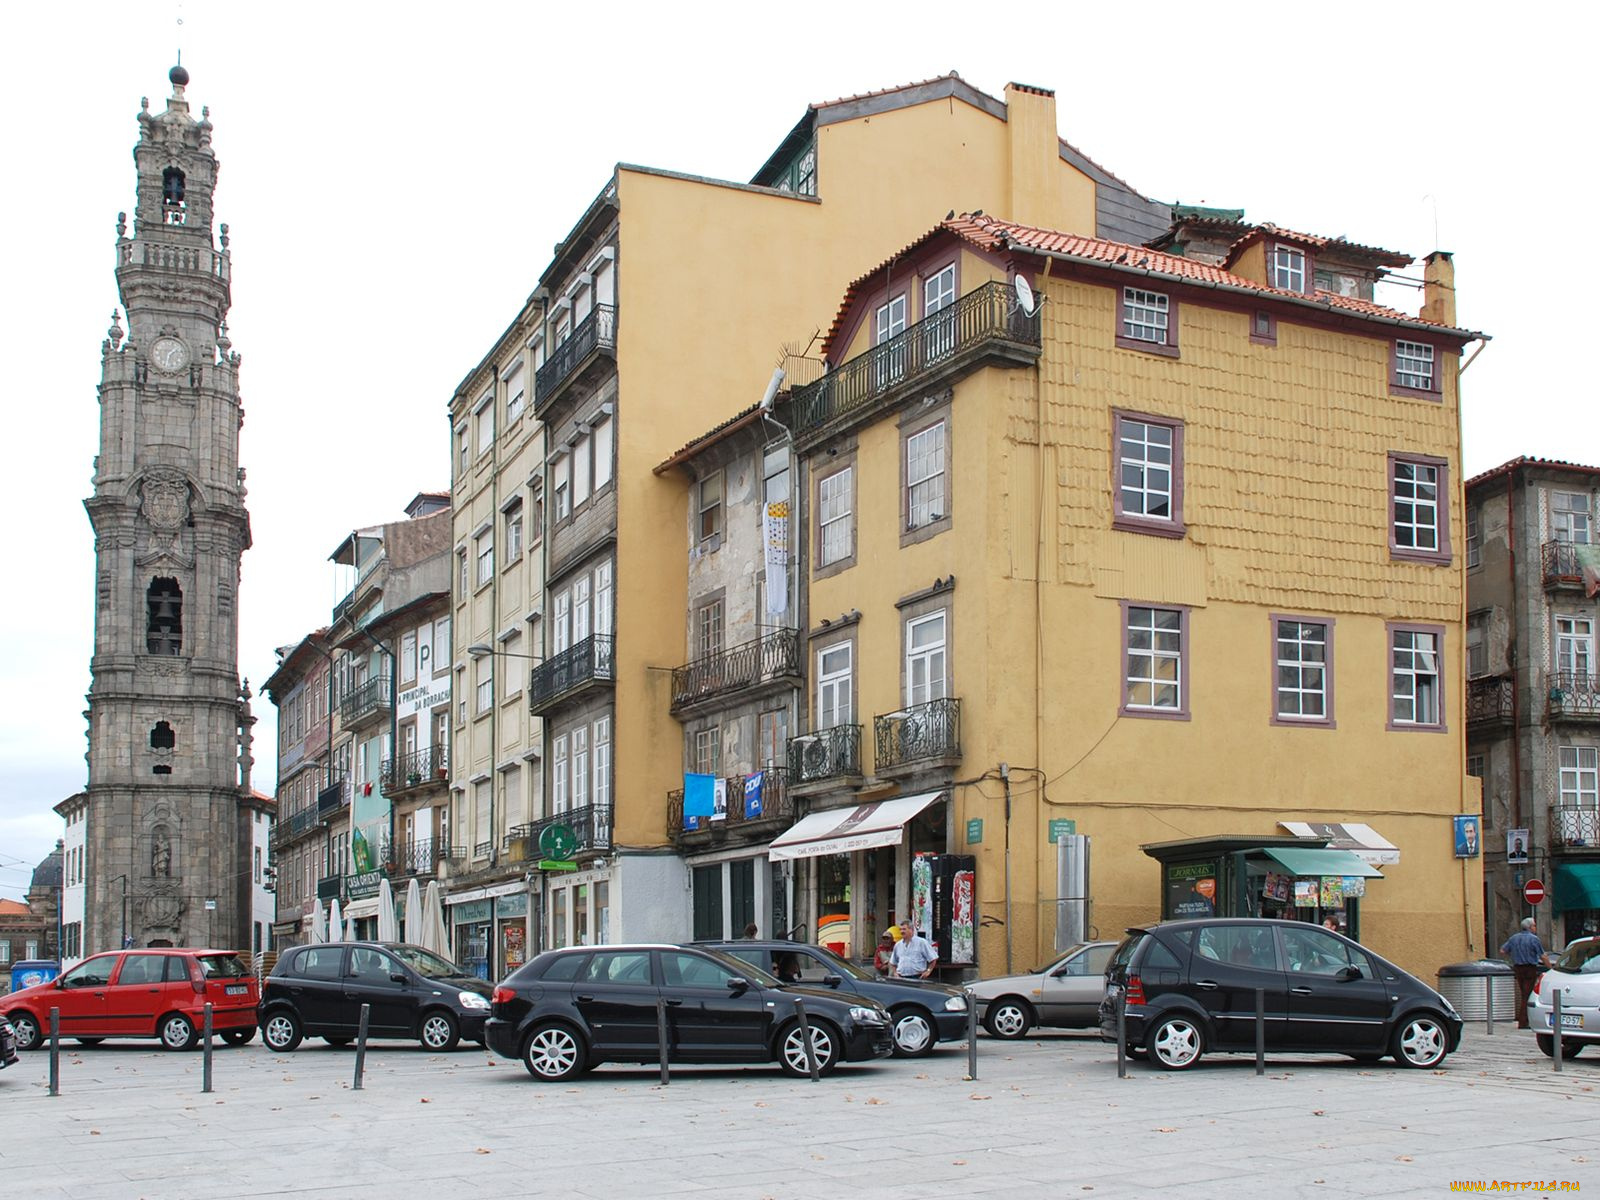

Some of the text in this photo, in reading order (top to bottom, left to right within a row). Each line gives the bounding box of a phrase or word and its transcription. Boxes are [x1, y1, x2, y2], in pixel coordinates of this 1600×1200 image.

[420, 644, 430, 671] P
[403, 685, 430, 704] PRINCIPAL
[415, 699, 422, 712] DA
[745, 774, 762, 794] CDU
[347, 871, 381, 889] CASA ORIENTA
[1174, 866, 1210, 877] JORNAIS
